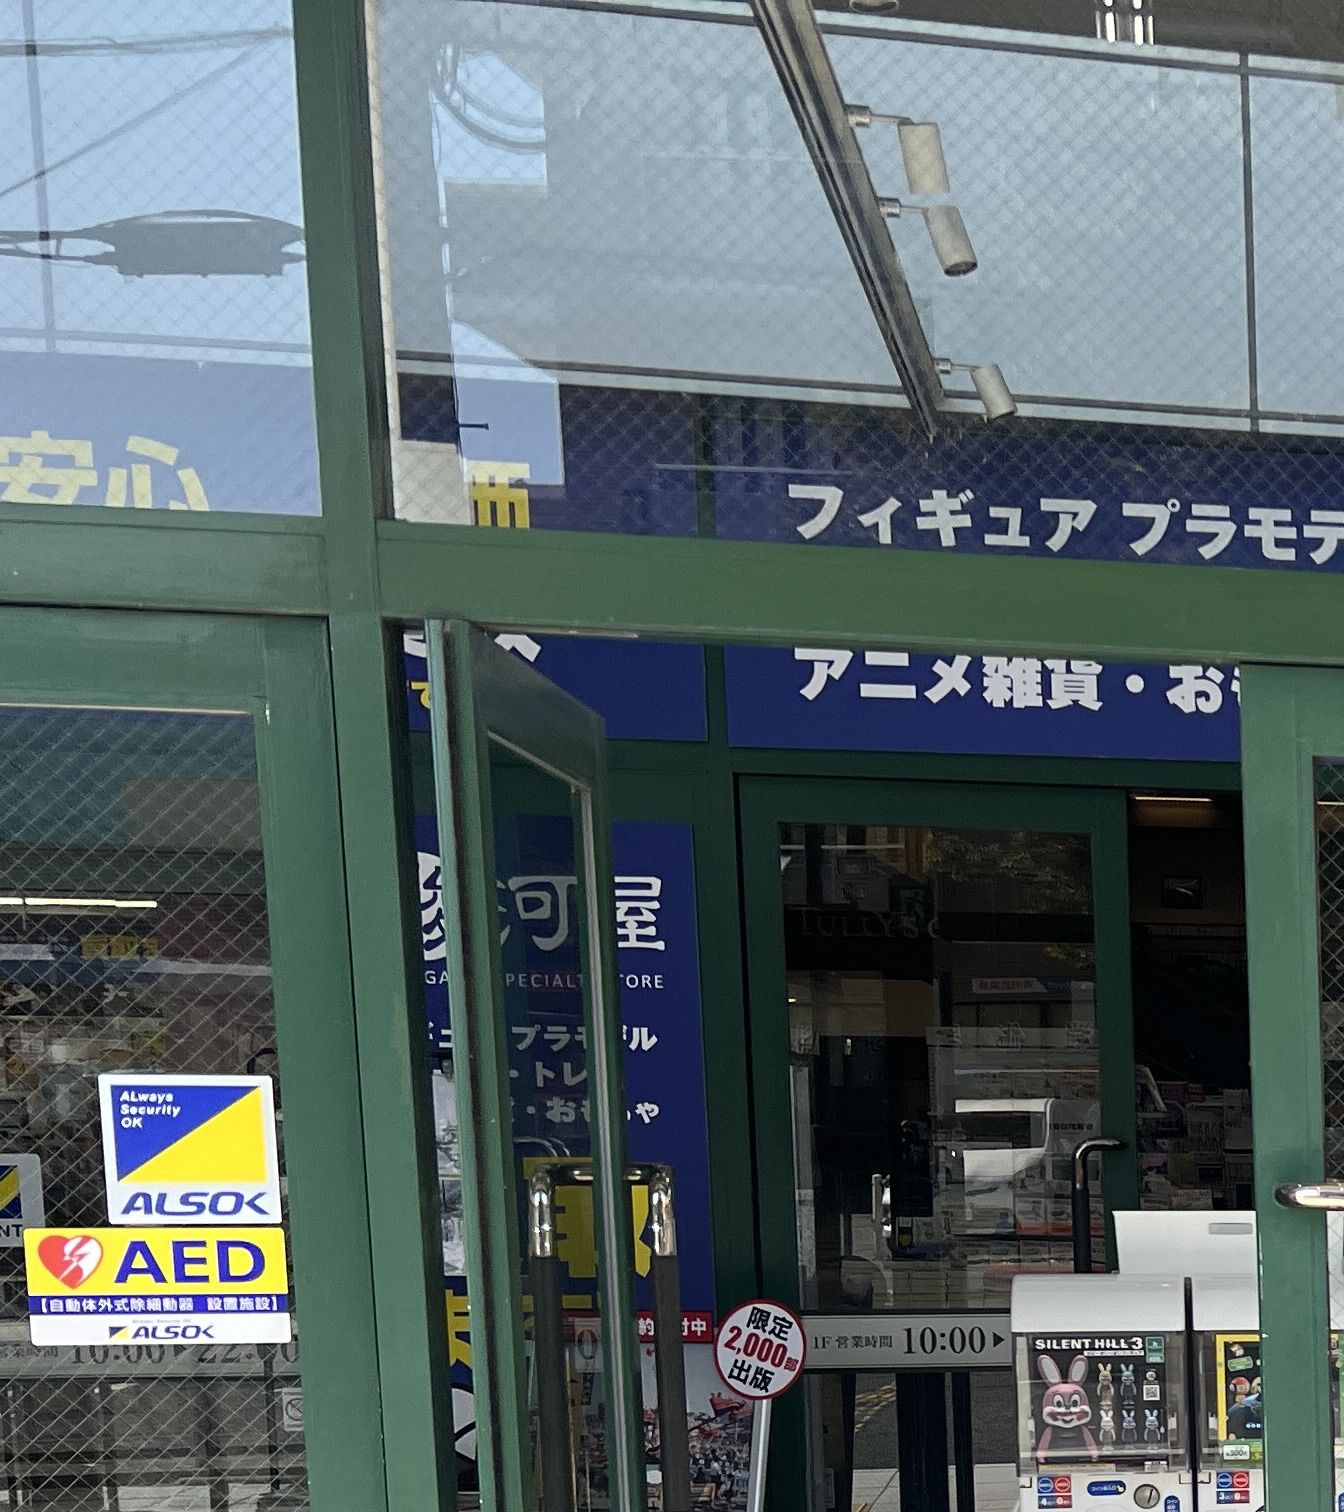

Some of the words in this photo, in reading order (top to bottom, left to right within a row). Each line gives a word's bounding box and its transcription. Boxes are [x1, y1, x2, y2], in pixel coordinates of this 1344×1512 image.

[788, 483, 1098, 552] フィギュア
[793, 646, 1240, 713] アニメ雑貨・お
[119, 1104, 181, 1117] Security
[120, 1117, 143, 1129] OK
[120, 1191, 271, 1216] ALSOK
[114, 1240, 266, 1284] AED
[132, 1325, 215, 1340] ALSOK
[746, 1305, 794, 1341] 限定
[813, 1336, 832, 1350] 1F
[835, 1335, 893, 1350] 営業時間
[902, 1326, 987, 1355] 10:00
[1035, 1338, 1091, 1350] SILENT
[1094, 1338, 1128, 1350] HILL
[1130, 1337, 1144, 1350] 3
[727, 1359, 776, 1393] 出版
